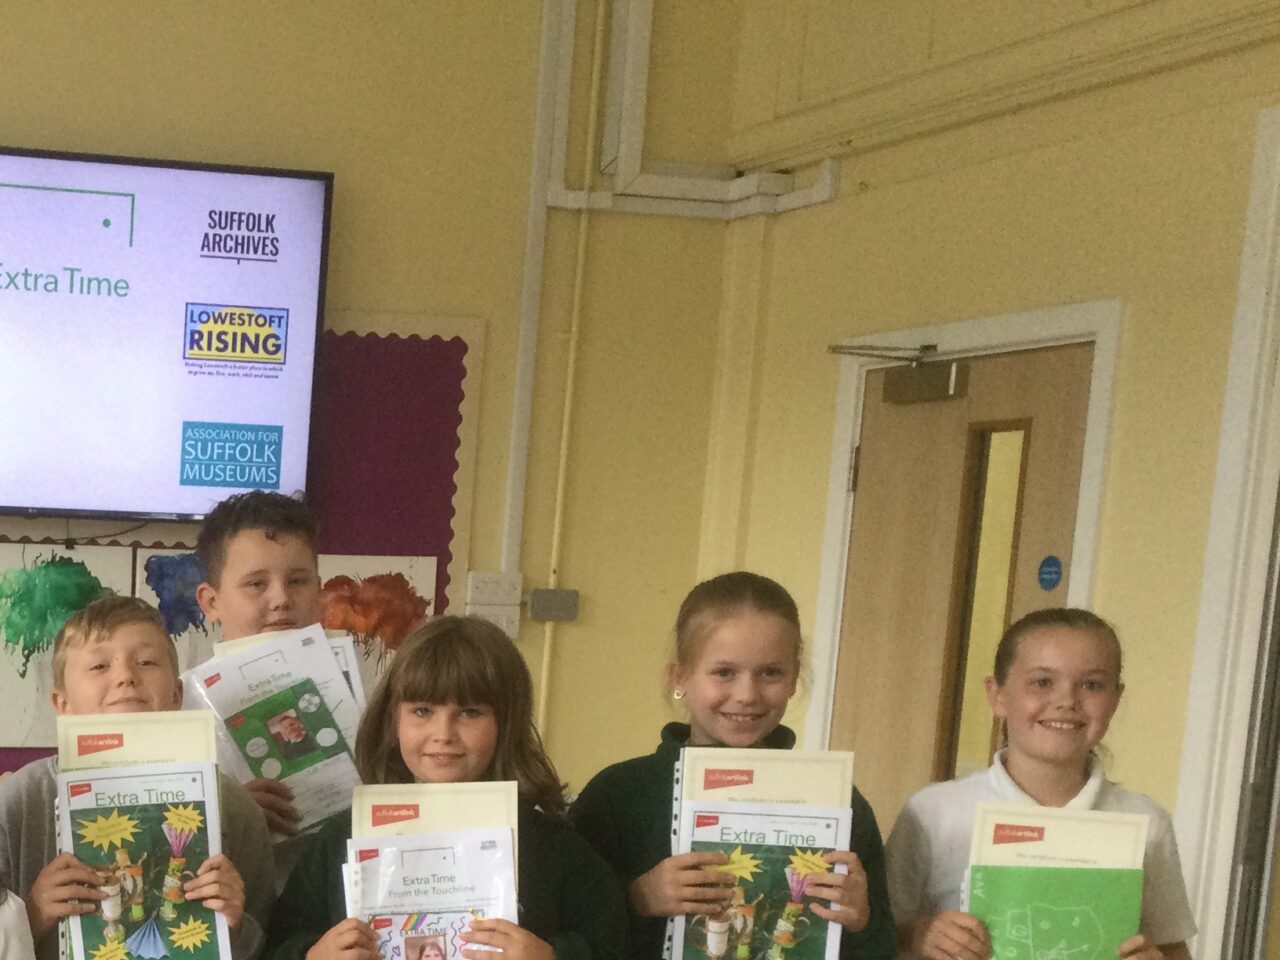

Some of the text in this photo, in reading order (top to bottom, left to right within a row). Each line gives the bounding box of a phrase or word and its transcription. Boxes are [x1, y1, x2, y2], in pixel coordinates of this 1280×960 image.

[208, 210, 276, 234] SUFFOLK
[200, 232, 280, 257] ARCHIVES
[63, 267, 130, 298] Time
[190, 309, 285, 329] LOWESTOFT
[189, 330, 282, 356] RISING
[185, 428, 279, 442] ASSOCIATION FOR
[184, 441, 276, 463] SUFFOLK
[183, 463, 277, 484] MUSEUMS
[94, 788, 186, 807] Extra Time
[720, 826, 817, 847] Extra Time
[402, 874, 456, 886] Extra Time
[388, 885, 476, 898] From the Touchline
